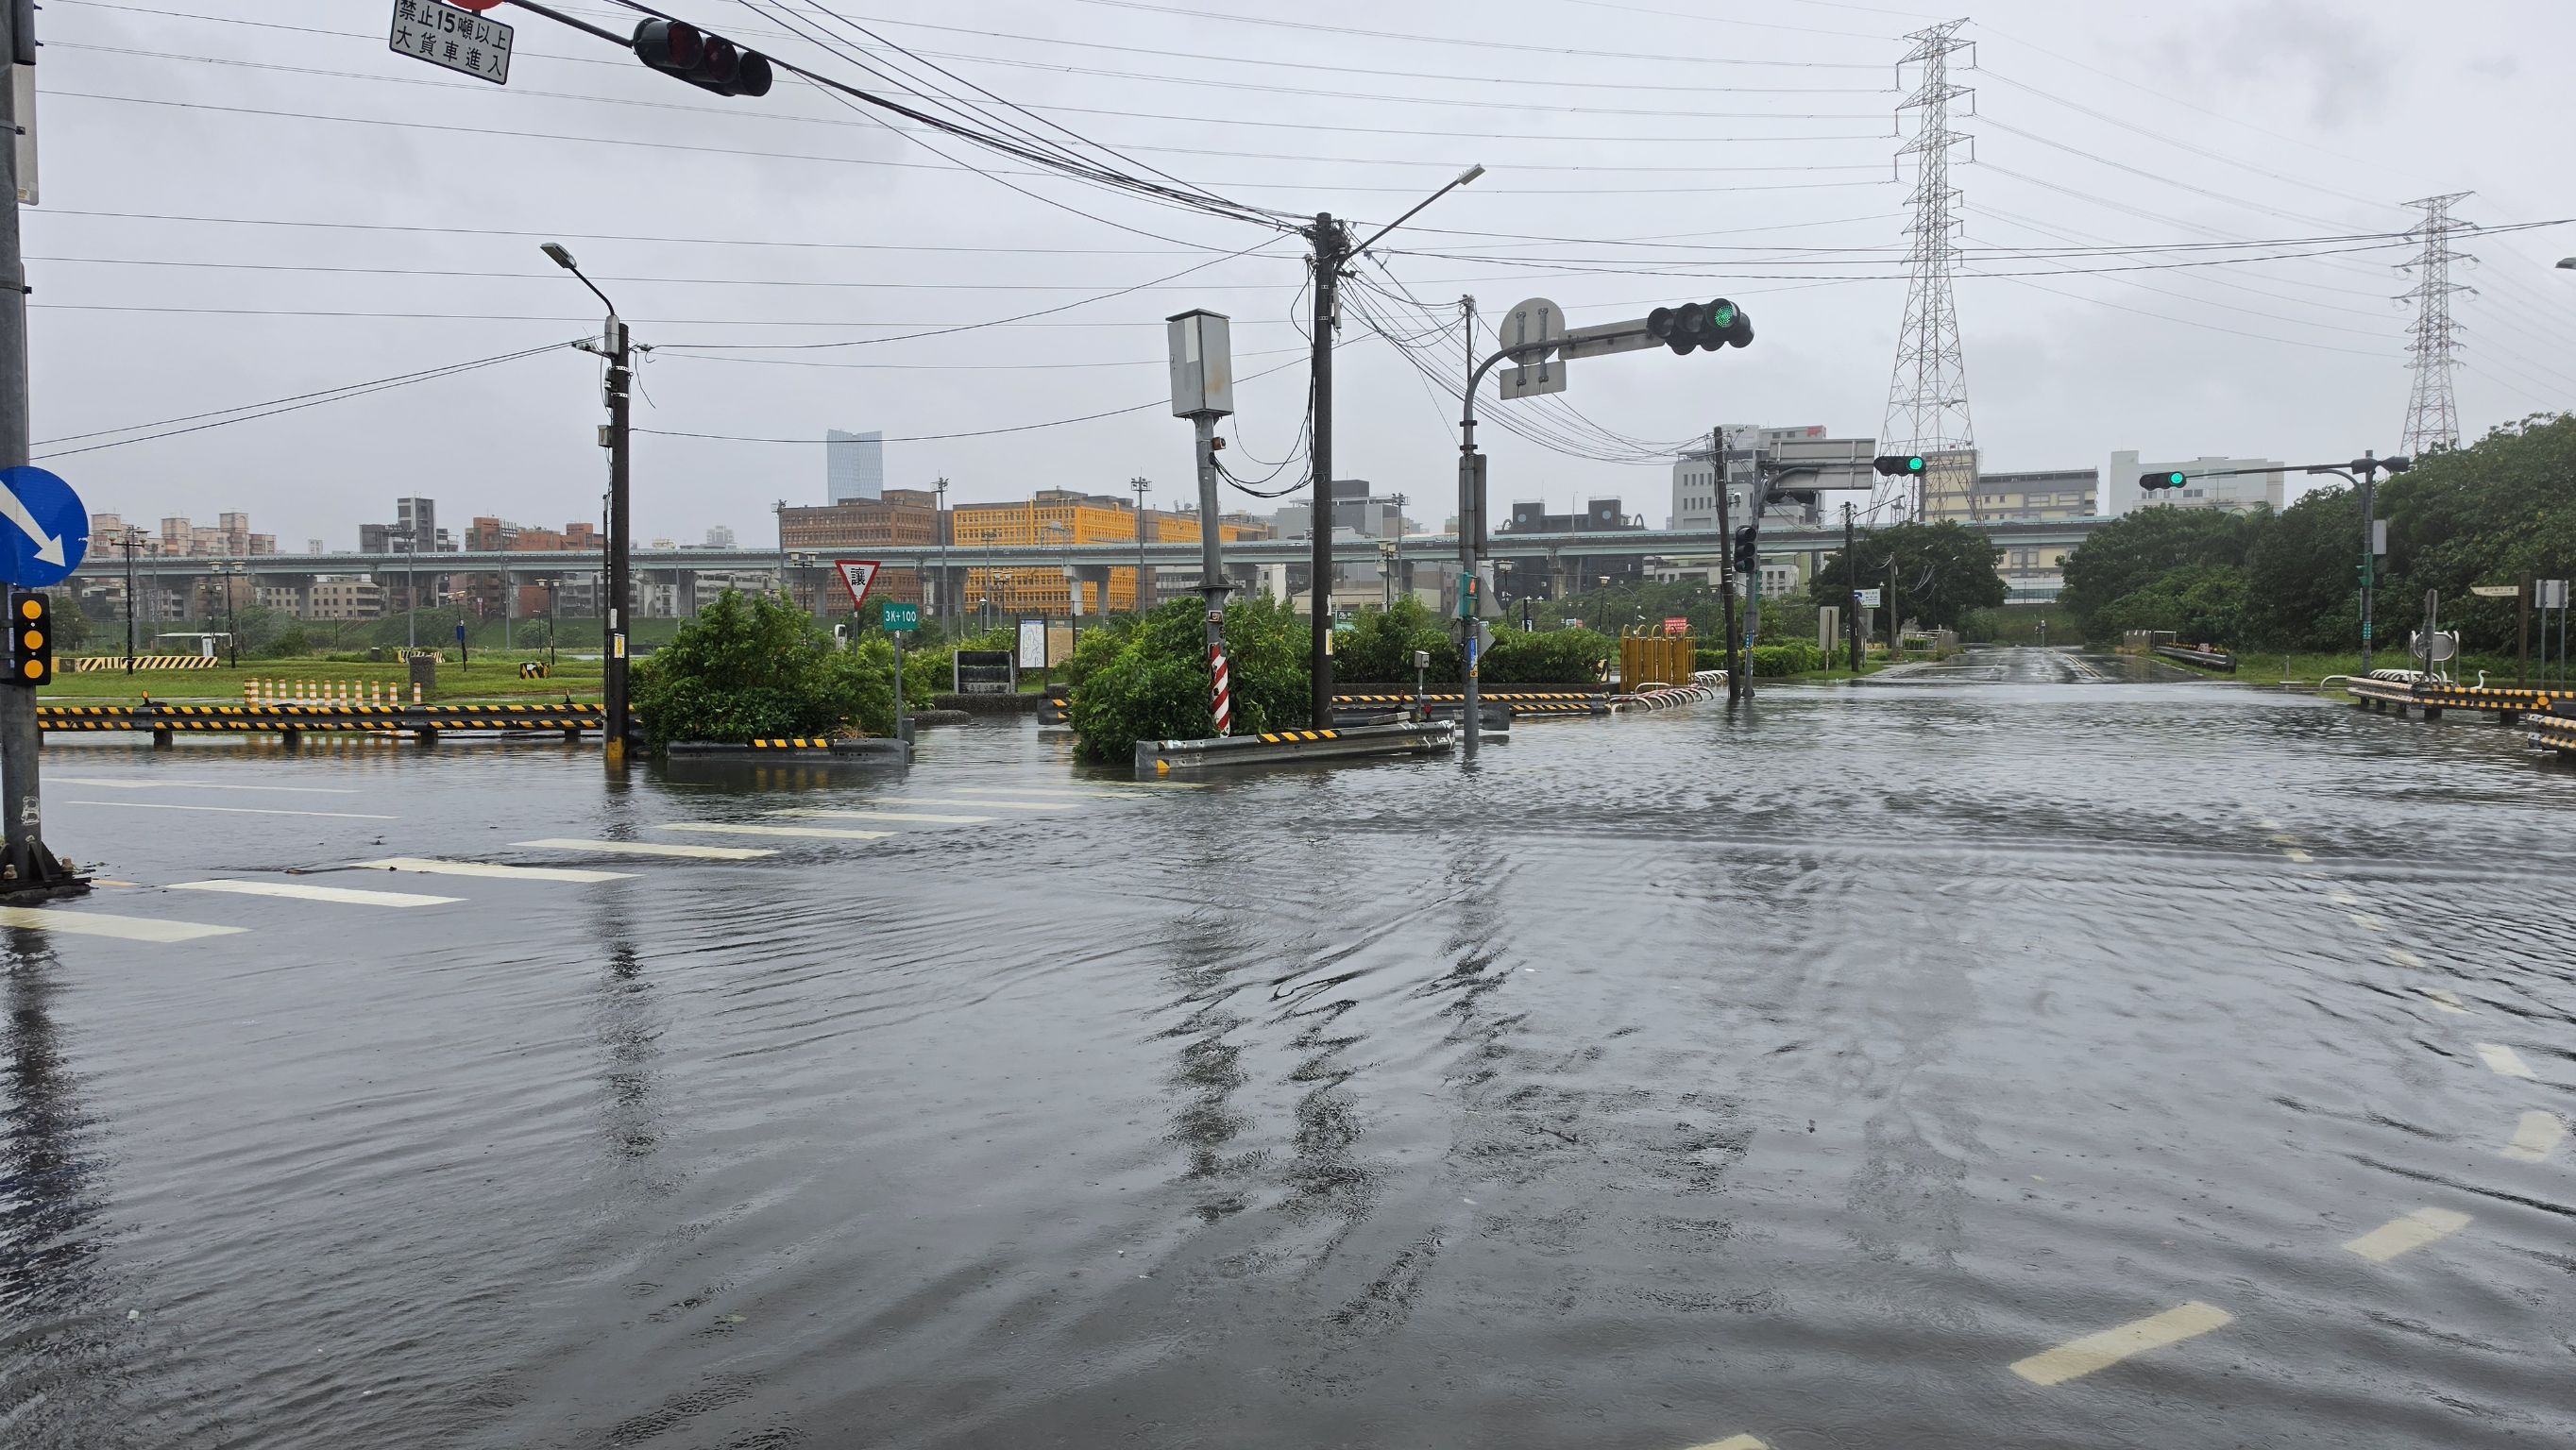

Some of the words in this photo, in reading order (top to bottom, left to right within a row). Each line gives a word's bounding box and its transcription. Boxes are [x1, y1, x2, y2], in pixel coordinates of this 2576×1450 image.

[396, 25, 501, 76] 大貨車進入
[851, 567, 865, 585] 讓
[886, 610, 916, 622] 3K+100
